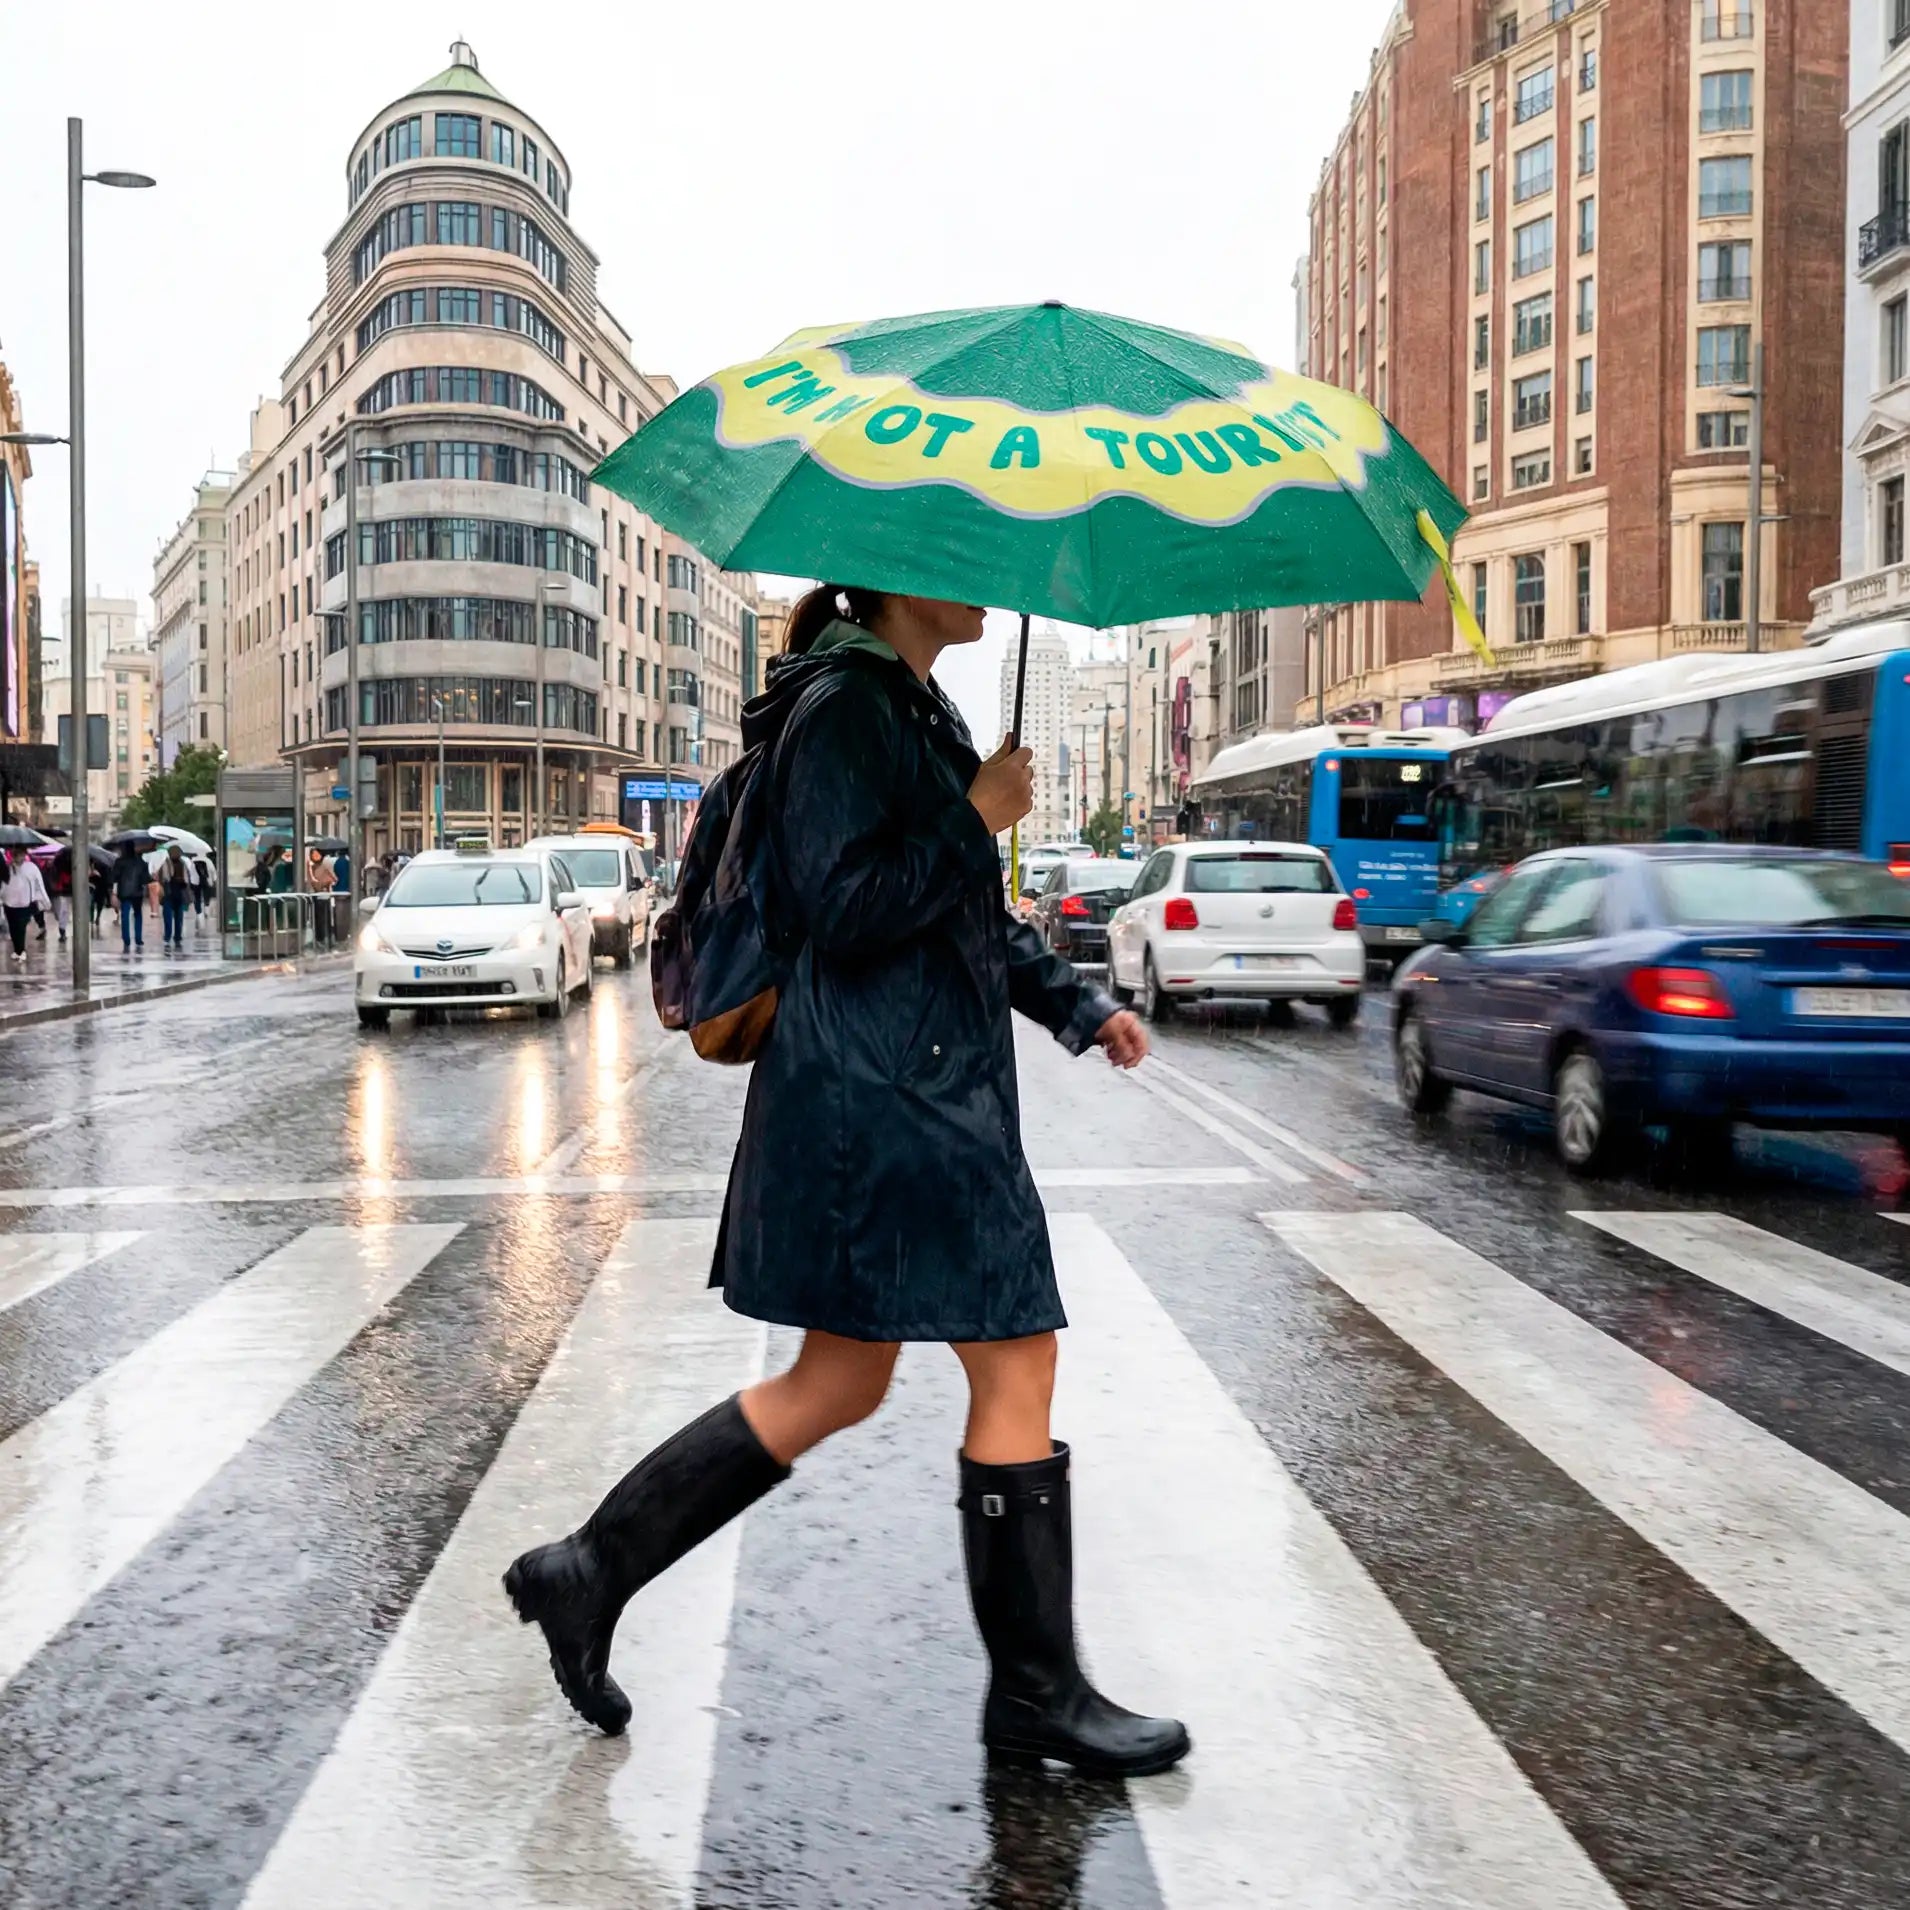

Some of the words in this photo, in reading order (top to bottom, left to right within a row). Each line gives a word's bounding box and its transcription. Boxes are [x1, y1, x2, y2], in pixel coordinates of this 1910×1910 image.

[743, 361, 837, 415] I'M
[812, 394, 976, 459] NOT
[989, 426, 1040, 470] A
